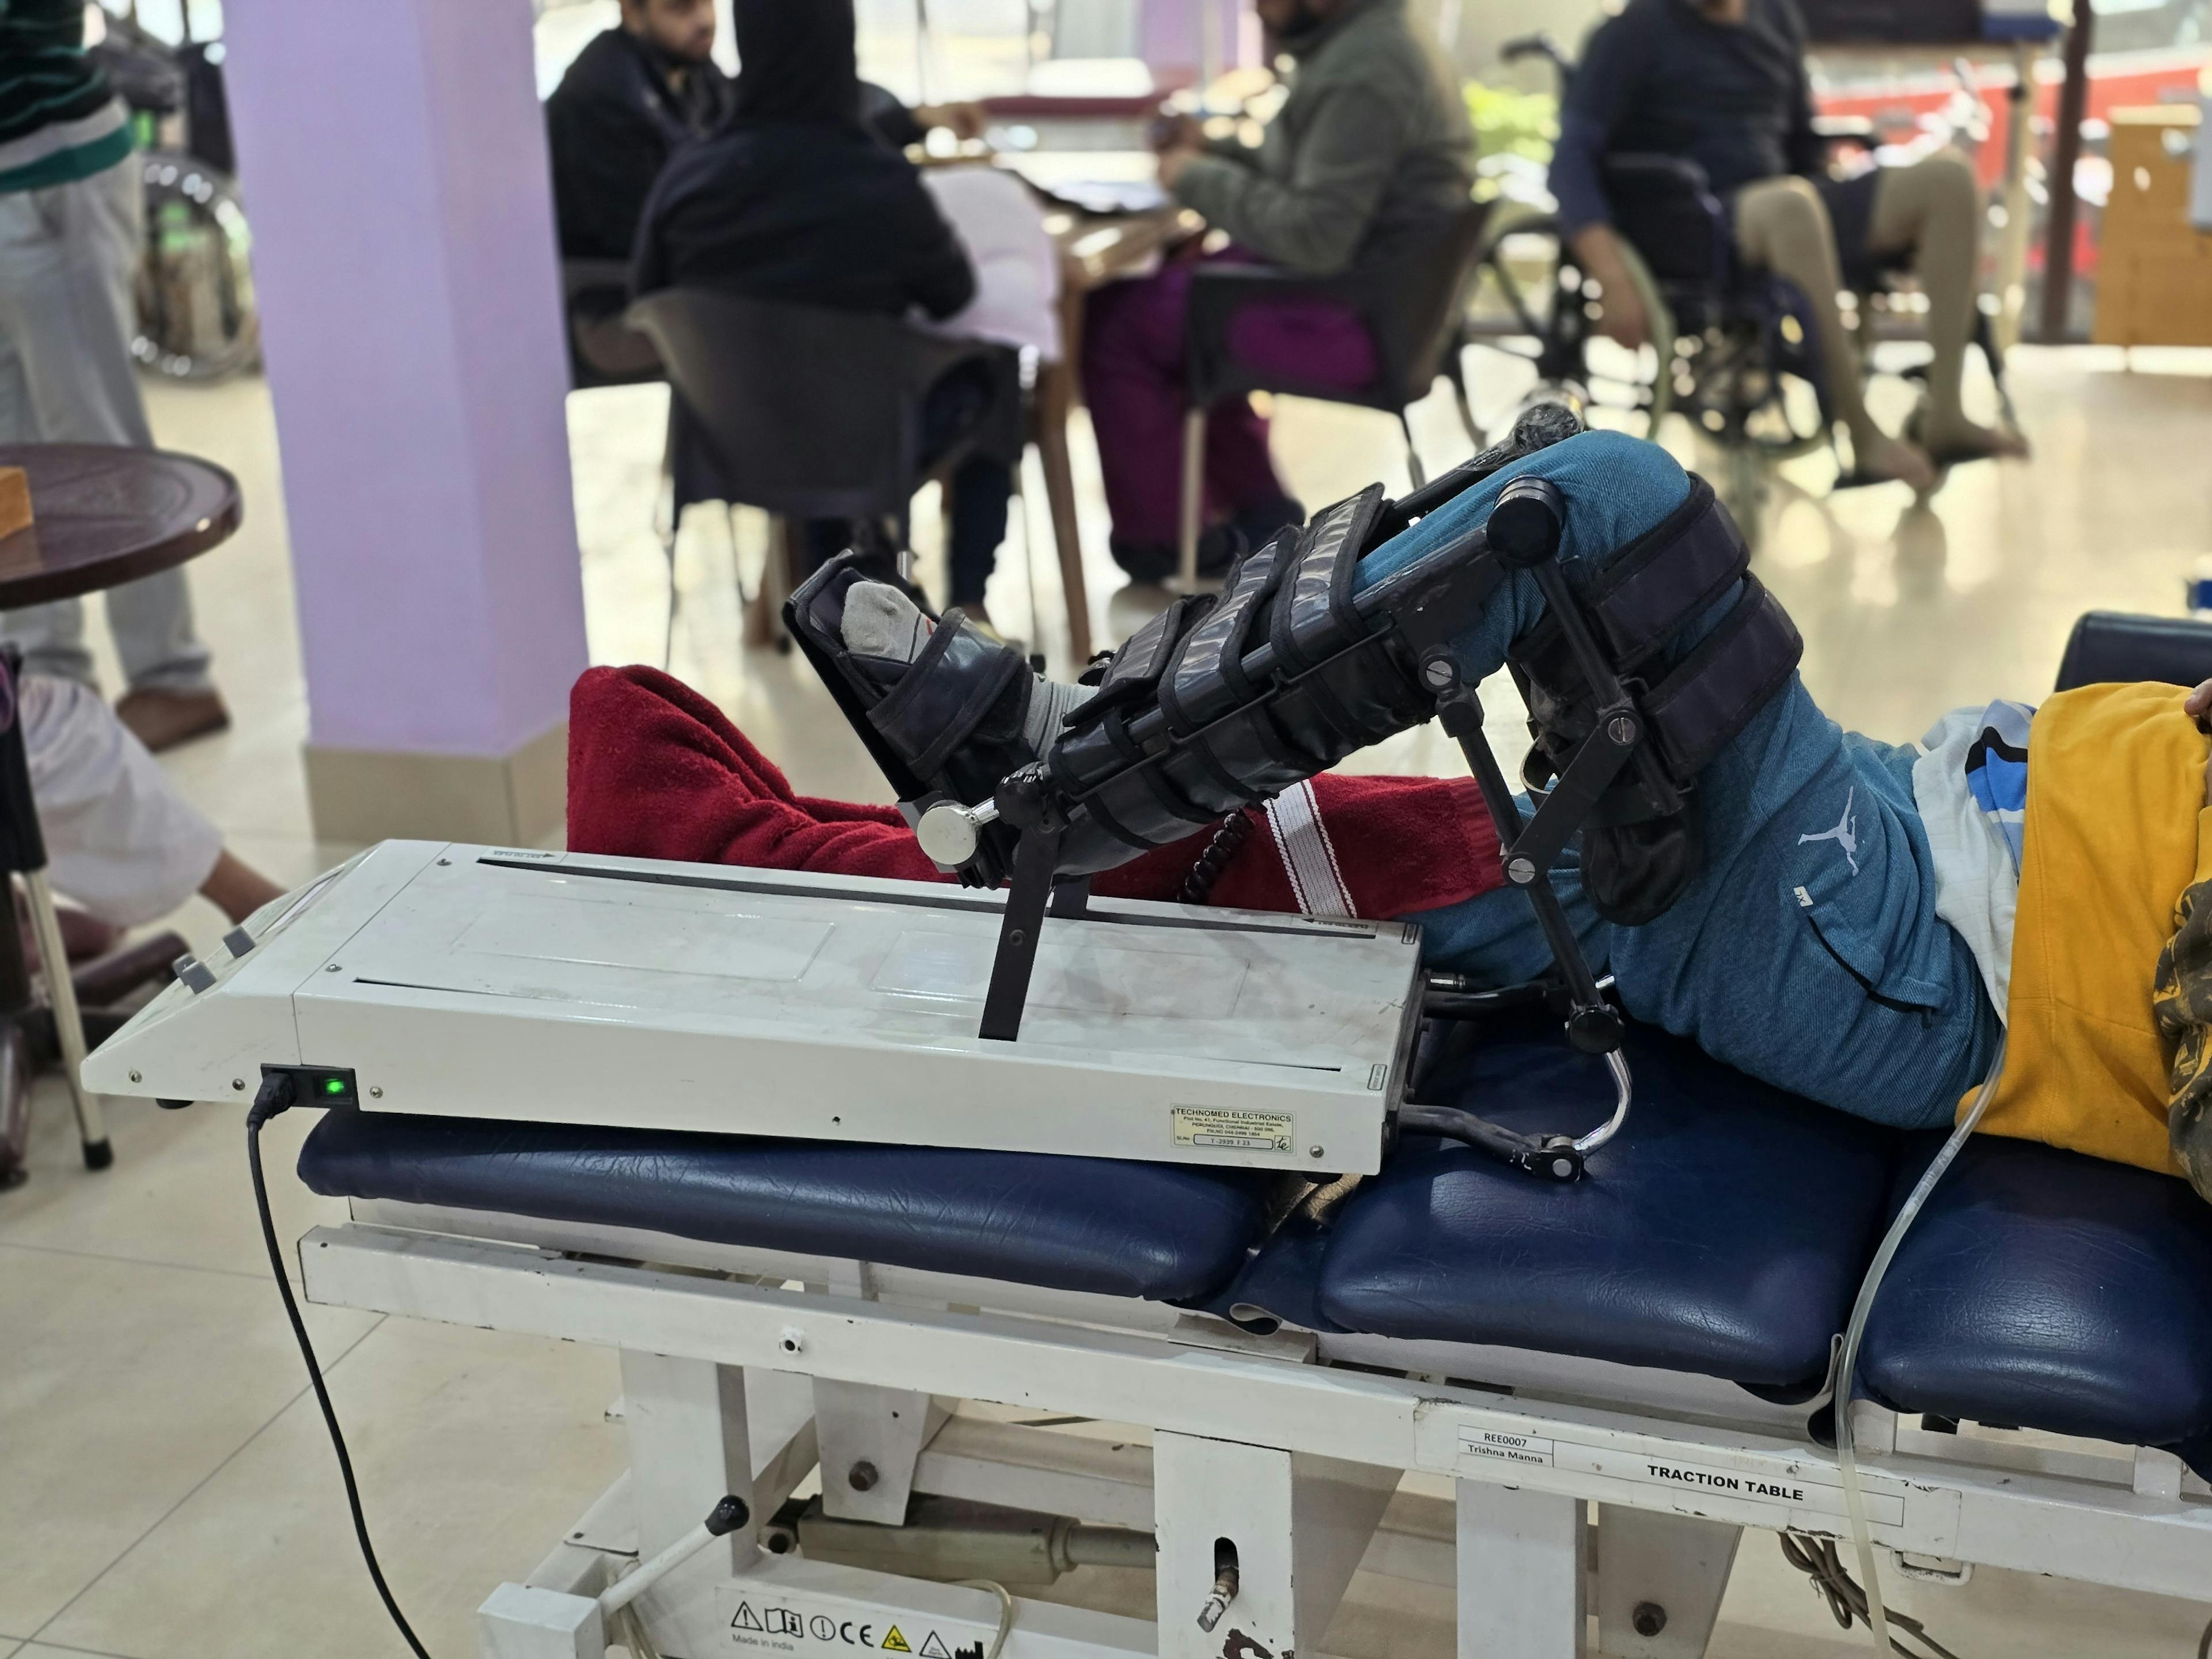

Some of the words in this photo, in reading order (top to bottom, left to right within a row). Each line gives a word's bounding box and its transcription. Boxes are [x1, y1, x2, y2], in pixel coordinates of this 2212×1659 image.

[1176, 1108, 1229, 1118] TECHNOMED
[1232, 1112, 1291, 1122] ELECTRONICS
[1484, 1433, 1527, 1447] REE0007
[1468, 1444, 1505, 1457] Trishna
[1508, 1451, 1543, 1463] Manna
[1647, 1465, 1738, 1490] TRACTION
[1745, 1481, 1803, 1501] TABLE
[733, 1634, 758, 1645] Made
[761, 1638, 769, 1647] in
